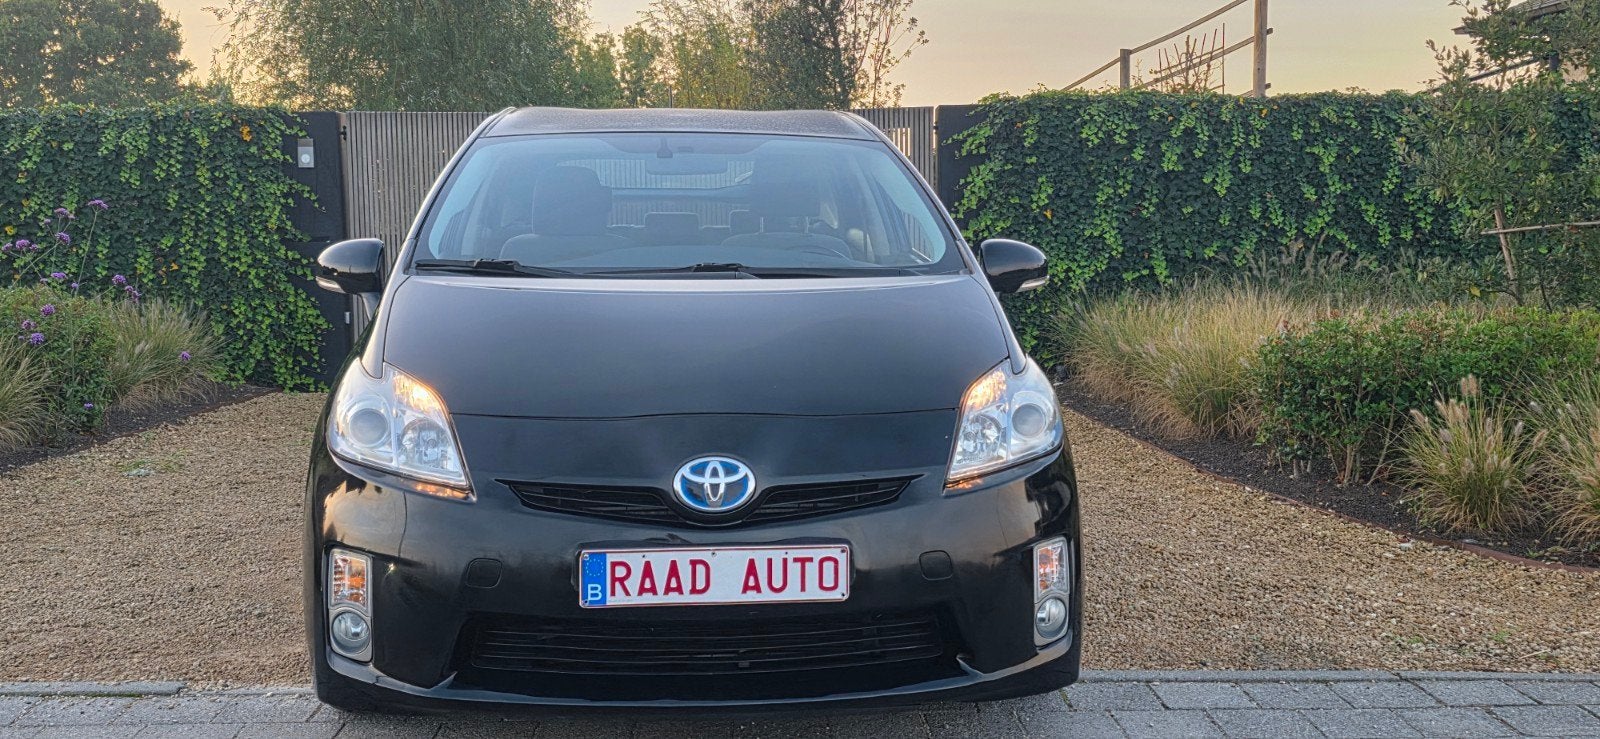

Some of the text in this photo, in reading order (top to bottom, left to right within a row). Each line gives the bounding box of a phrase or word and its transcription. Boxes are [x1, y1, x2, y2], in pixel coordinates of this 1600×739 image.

[609, 556, 840, 597] RAAD AUTO
[587, 583, 602, 601] B
